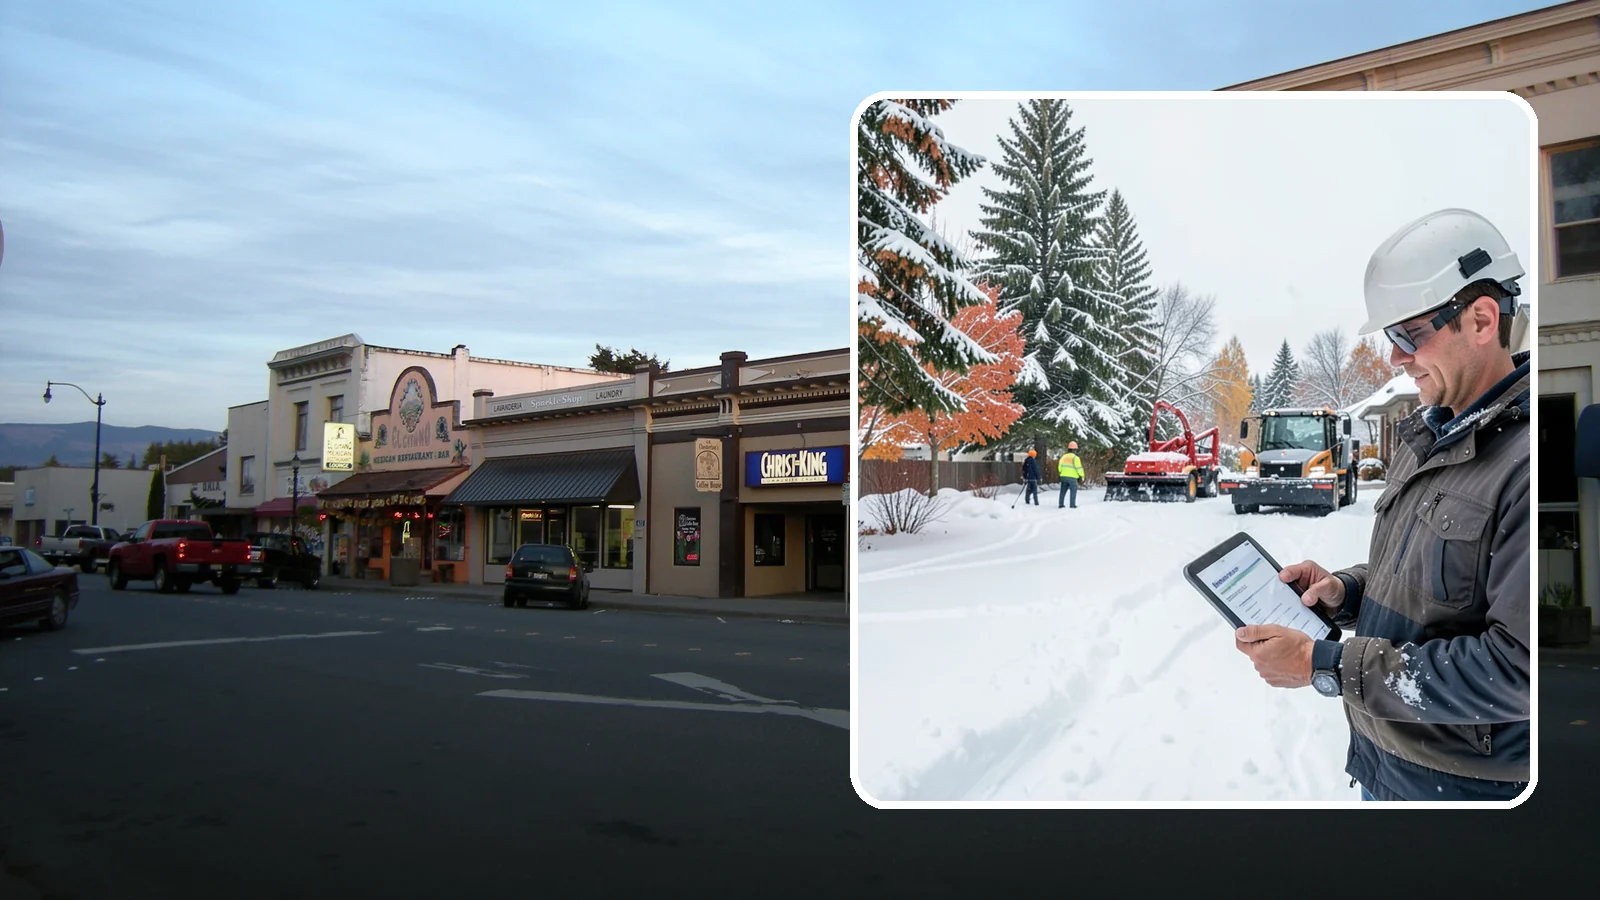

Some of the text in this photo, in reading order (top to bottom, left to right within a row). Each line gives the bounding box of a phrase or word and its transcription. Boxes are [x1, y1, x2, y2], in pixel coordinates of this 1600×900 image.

[493, 402, 522, 412] LAVANDERIA
[561, 394, 582, 405] Shop
[595, 389, 623, 400] LAUNDRY
[374, 455, 396, 464] MEXICAN
[398, 451, 433, 462] RESTAURANT
[438, 450, 450, 459] BAR
[761, 450, 827, 477] CHRIST KING
